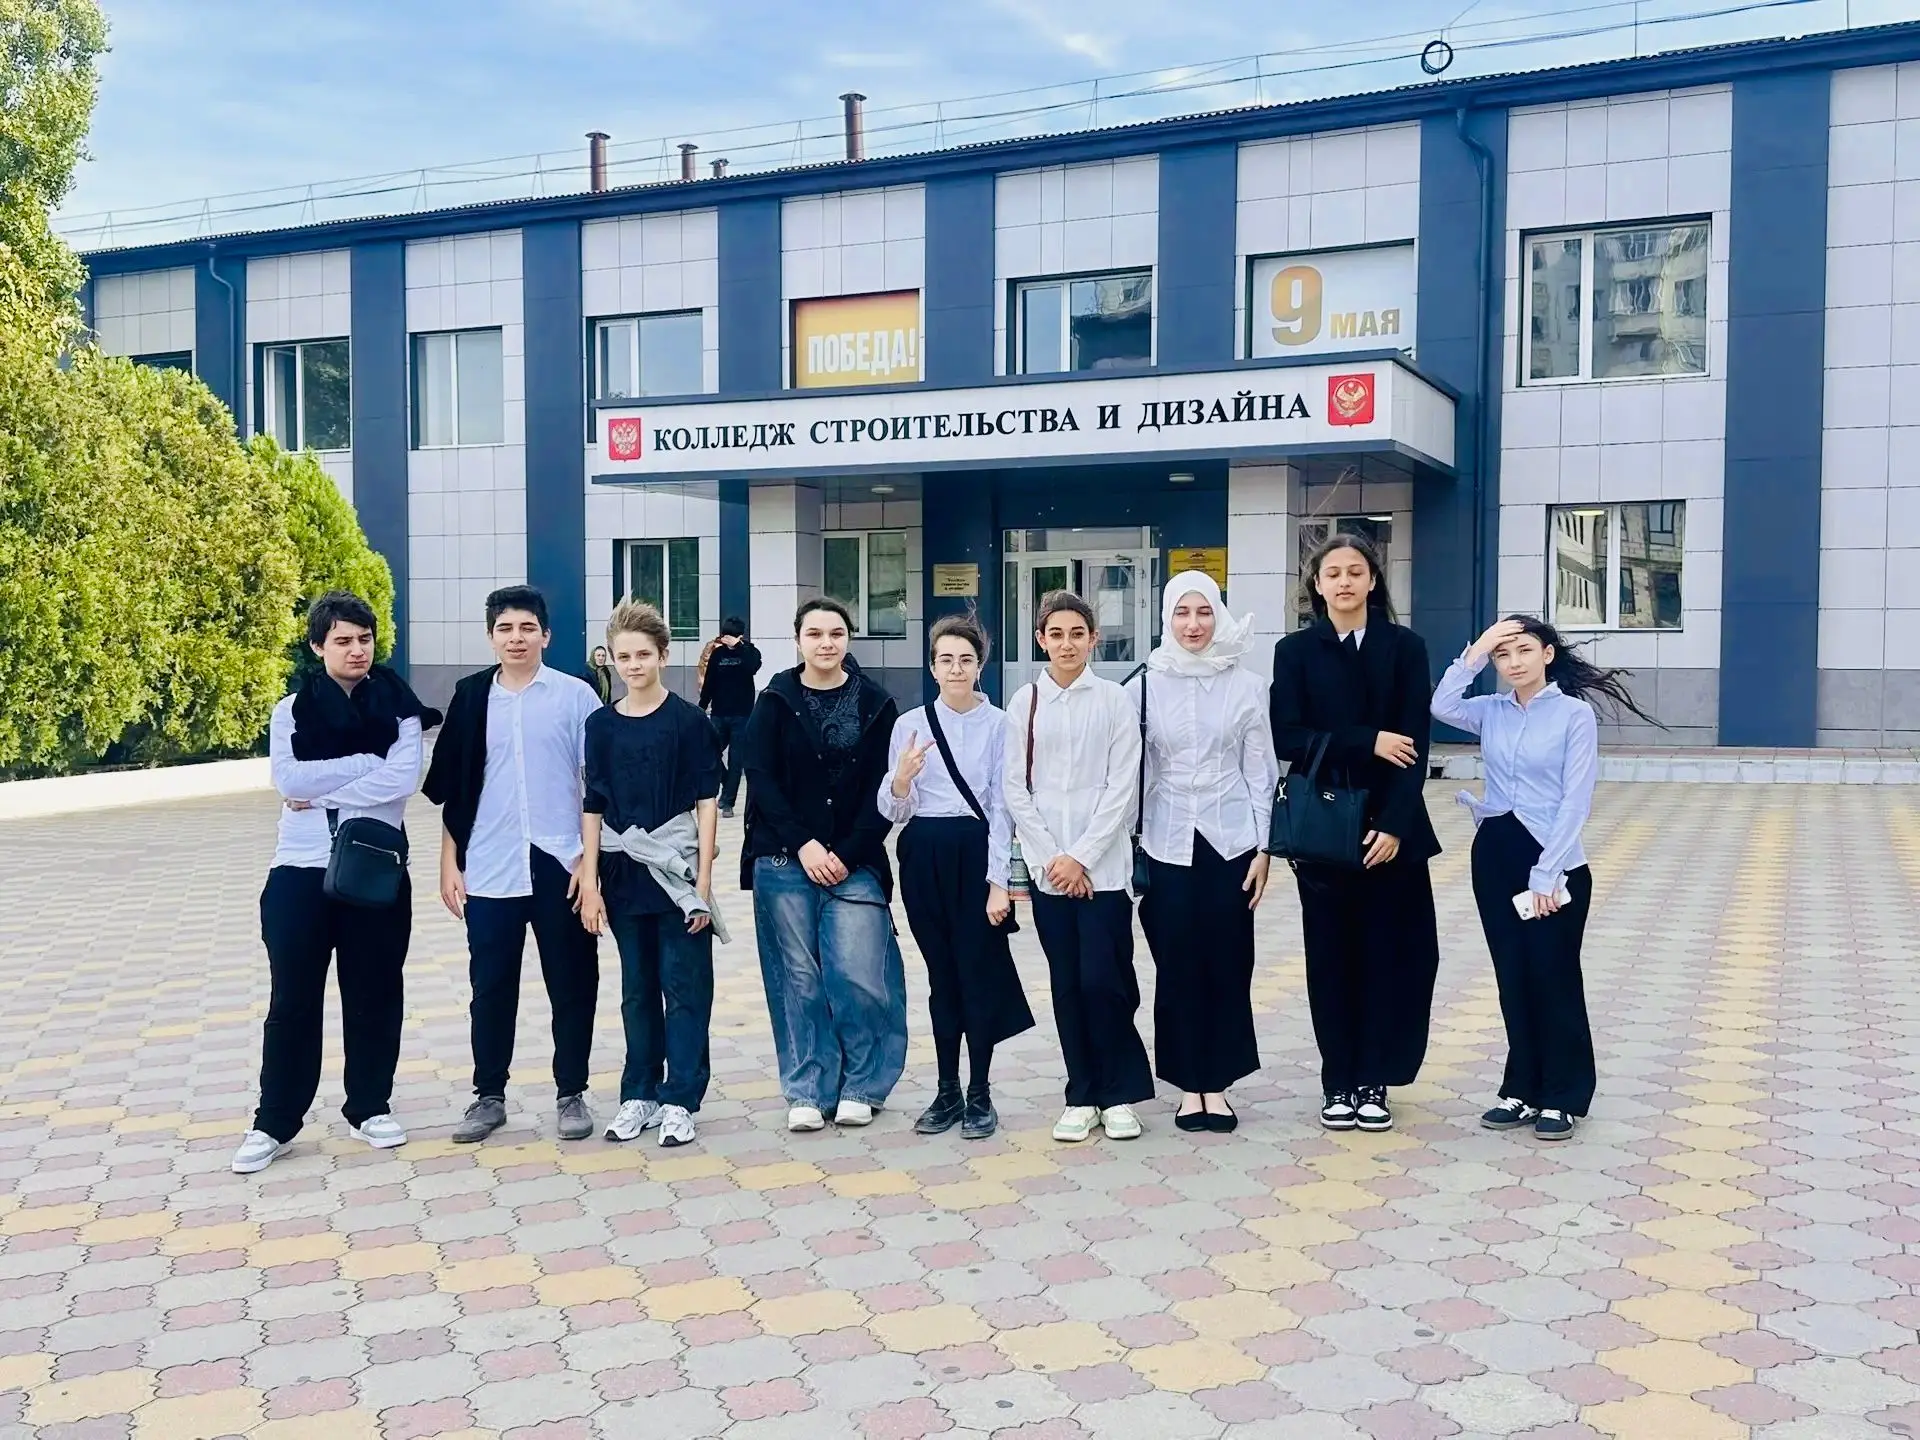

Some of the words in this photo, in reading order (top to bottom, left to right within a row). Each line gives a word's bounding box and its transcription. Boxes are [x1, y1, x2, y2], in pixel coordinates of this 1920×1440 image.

[1271, 265, 1323, 346] 9
[1330, 308, 1400, 339] МАЯ
[808, 328, 916, 376] ПОБЕДА!
[653, 422, 796, 453] КОЛЛЕДЖ
[809, 405, 1081, 444] СТРОИТЕЛЬСТВА
[1096, 404, 1121, 430] И
[1137, 389, 1312, 434] ДИЗАЙНА
